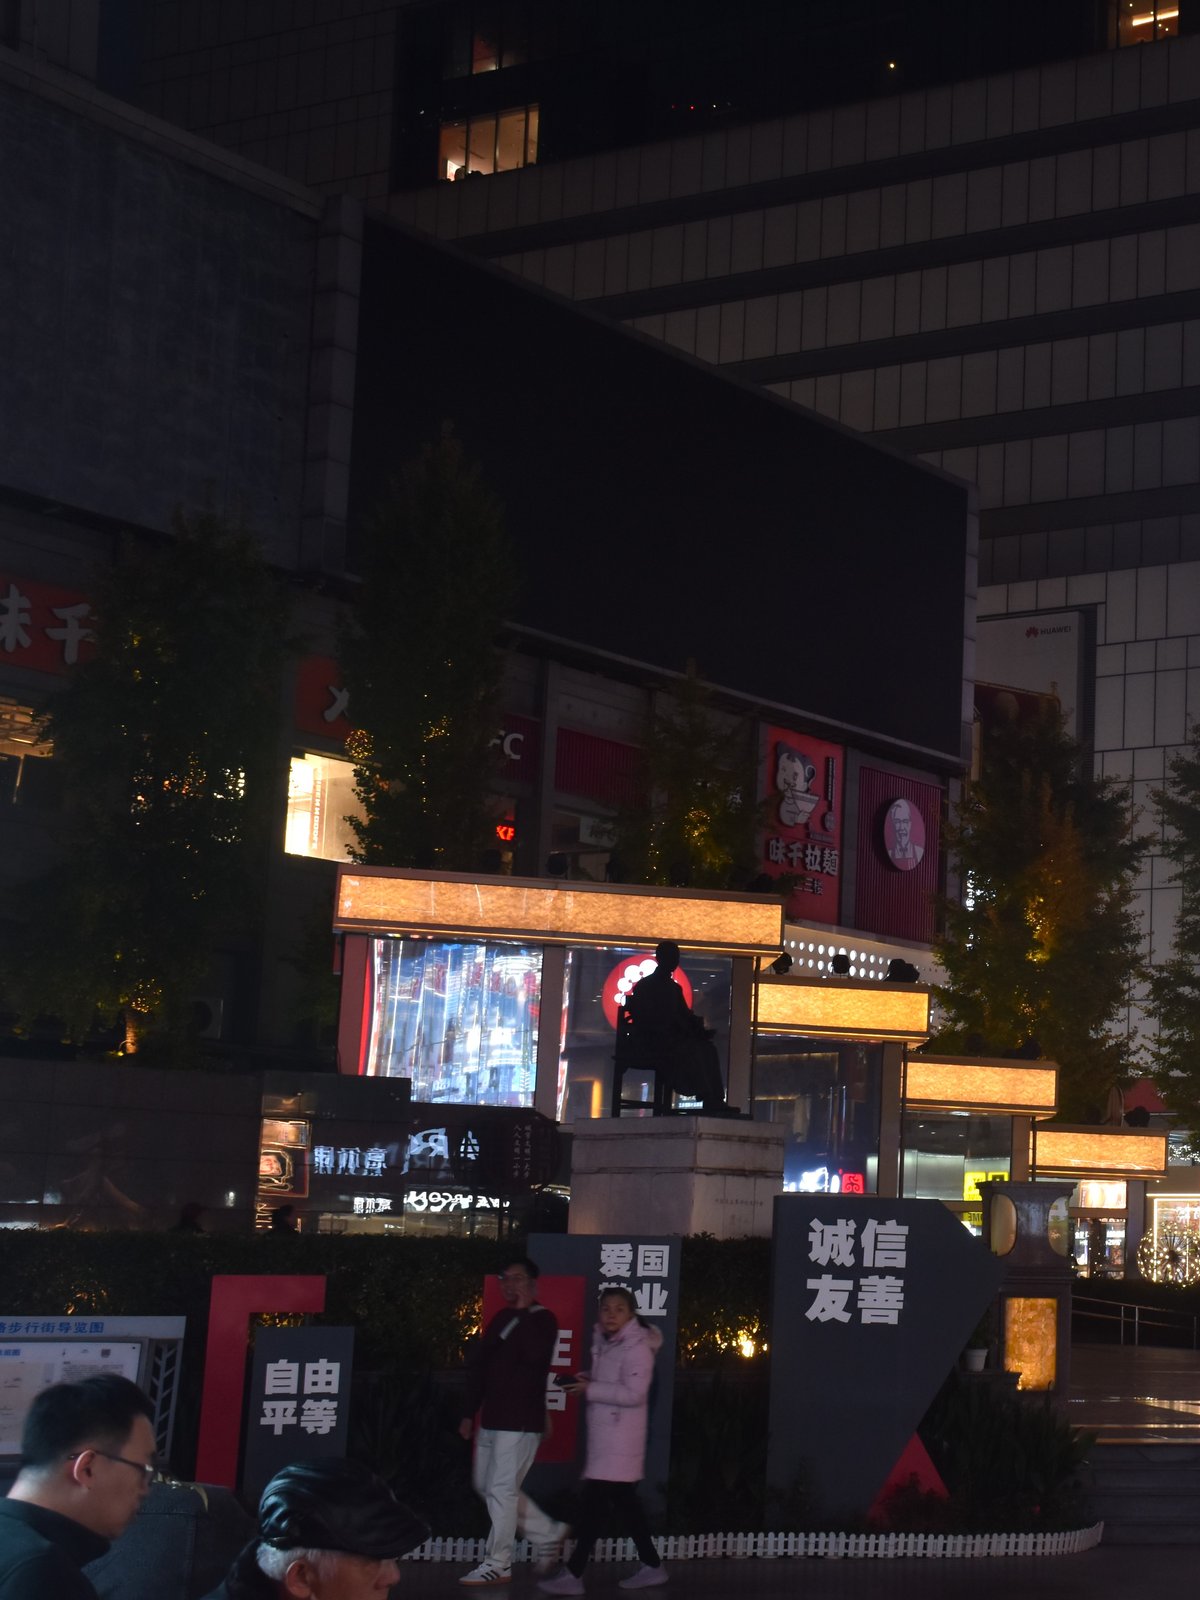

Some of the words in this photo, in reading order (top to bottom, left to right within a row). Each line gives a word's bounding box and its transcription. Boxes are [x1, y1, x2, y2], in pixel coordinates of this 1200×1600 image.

[1041, 625, 1071, 635] HUAWEI
[599, 1243, 670, 1278] 爱国
[807, 1218, 909, 1269] 诚信
[804, 1274, 906, 1325] 友善
[264, 1358, 341, 1395] 自由
[260, 1399, 338, 1435] 平等
